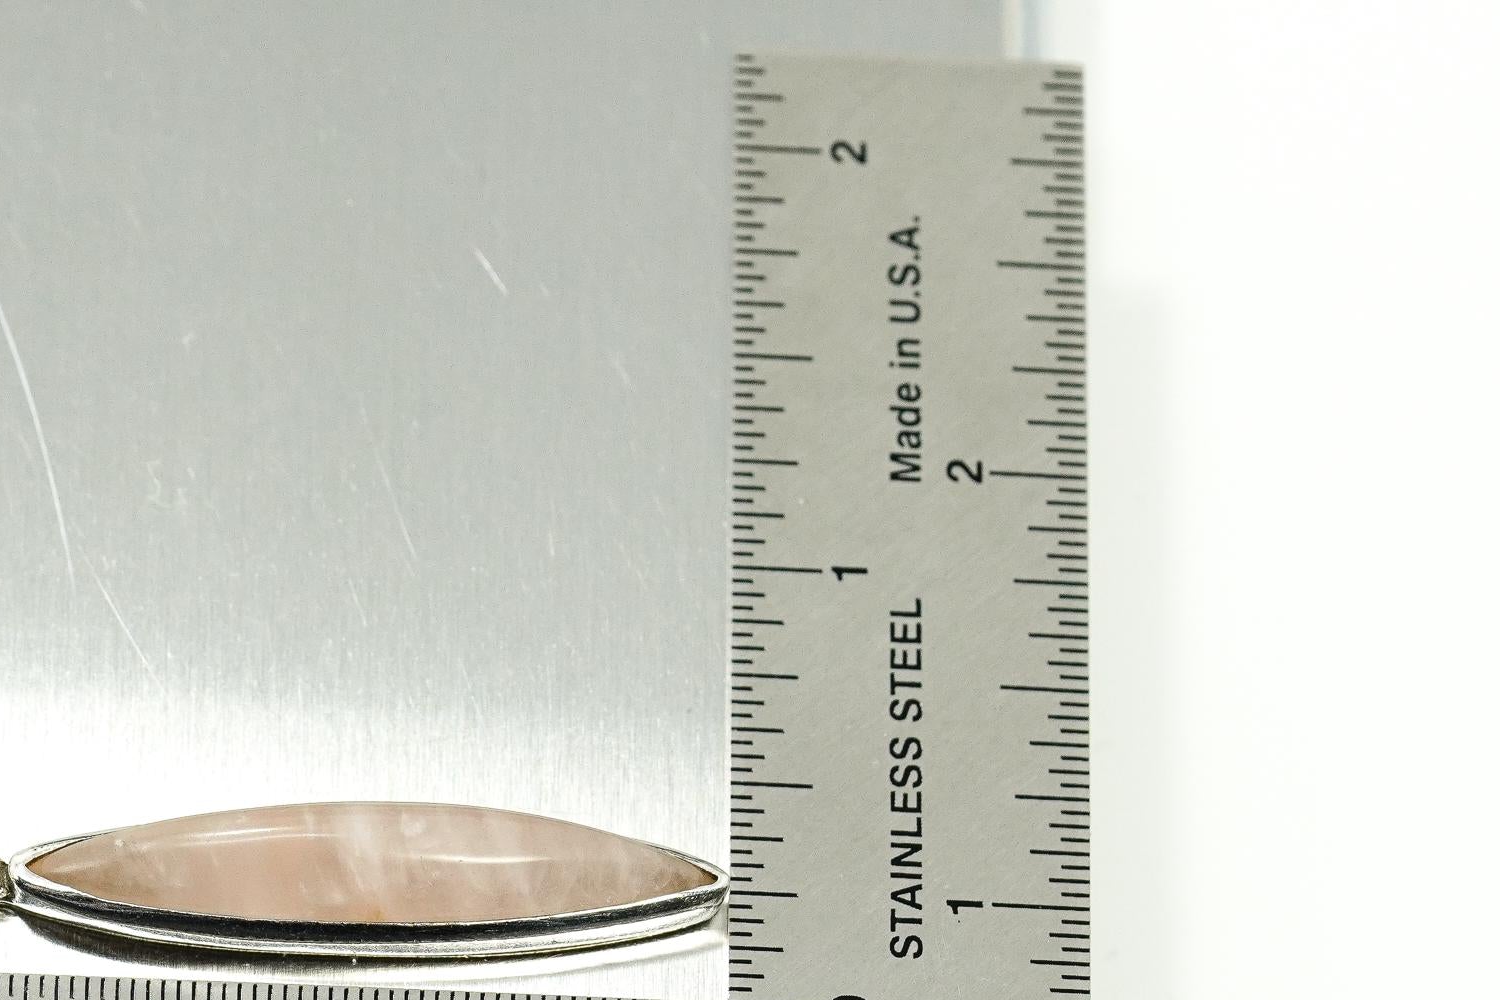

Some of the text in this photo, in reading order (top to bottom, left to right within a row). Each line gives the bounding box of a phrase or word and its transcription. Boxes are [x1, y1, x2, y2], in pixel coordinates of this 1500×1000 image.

[828, 139, 869, 166] 2
[887, 214, 923, 484] Made in U.S.A.
[946, 458, 984, 485] 2
[830, 566, 869, 583] 1
[888, 597, 925, 961] STAINLESS STEEL
[946, 898, 985, 917] 1
